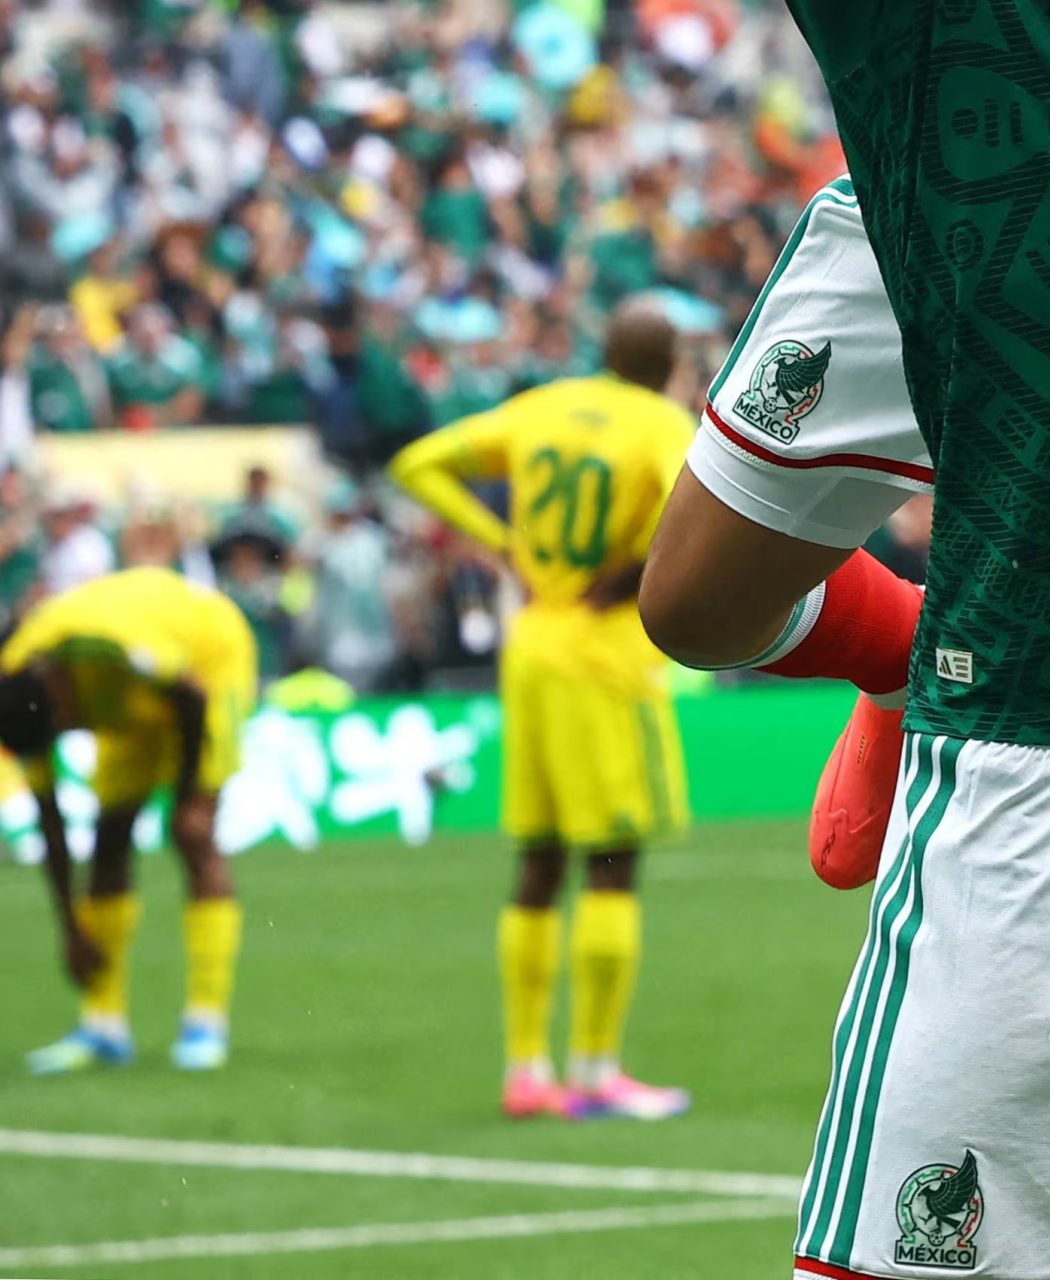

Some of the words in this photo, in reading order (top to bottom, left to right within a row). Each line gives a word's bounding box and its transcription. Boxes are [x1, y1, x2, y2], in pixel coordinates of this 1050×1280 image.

[736, 398, 793, 440] MÉXICO
[527, 445, 613, 570] 20
[899, 1243, 972, 1265] MÉXICO
